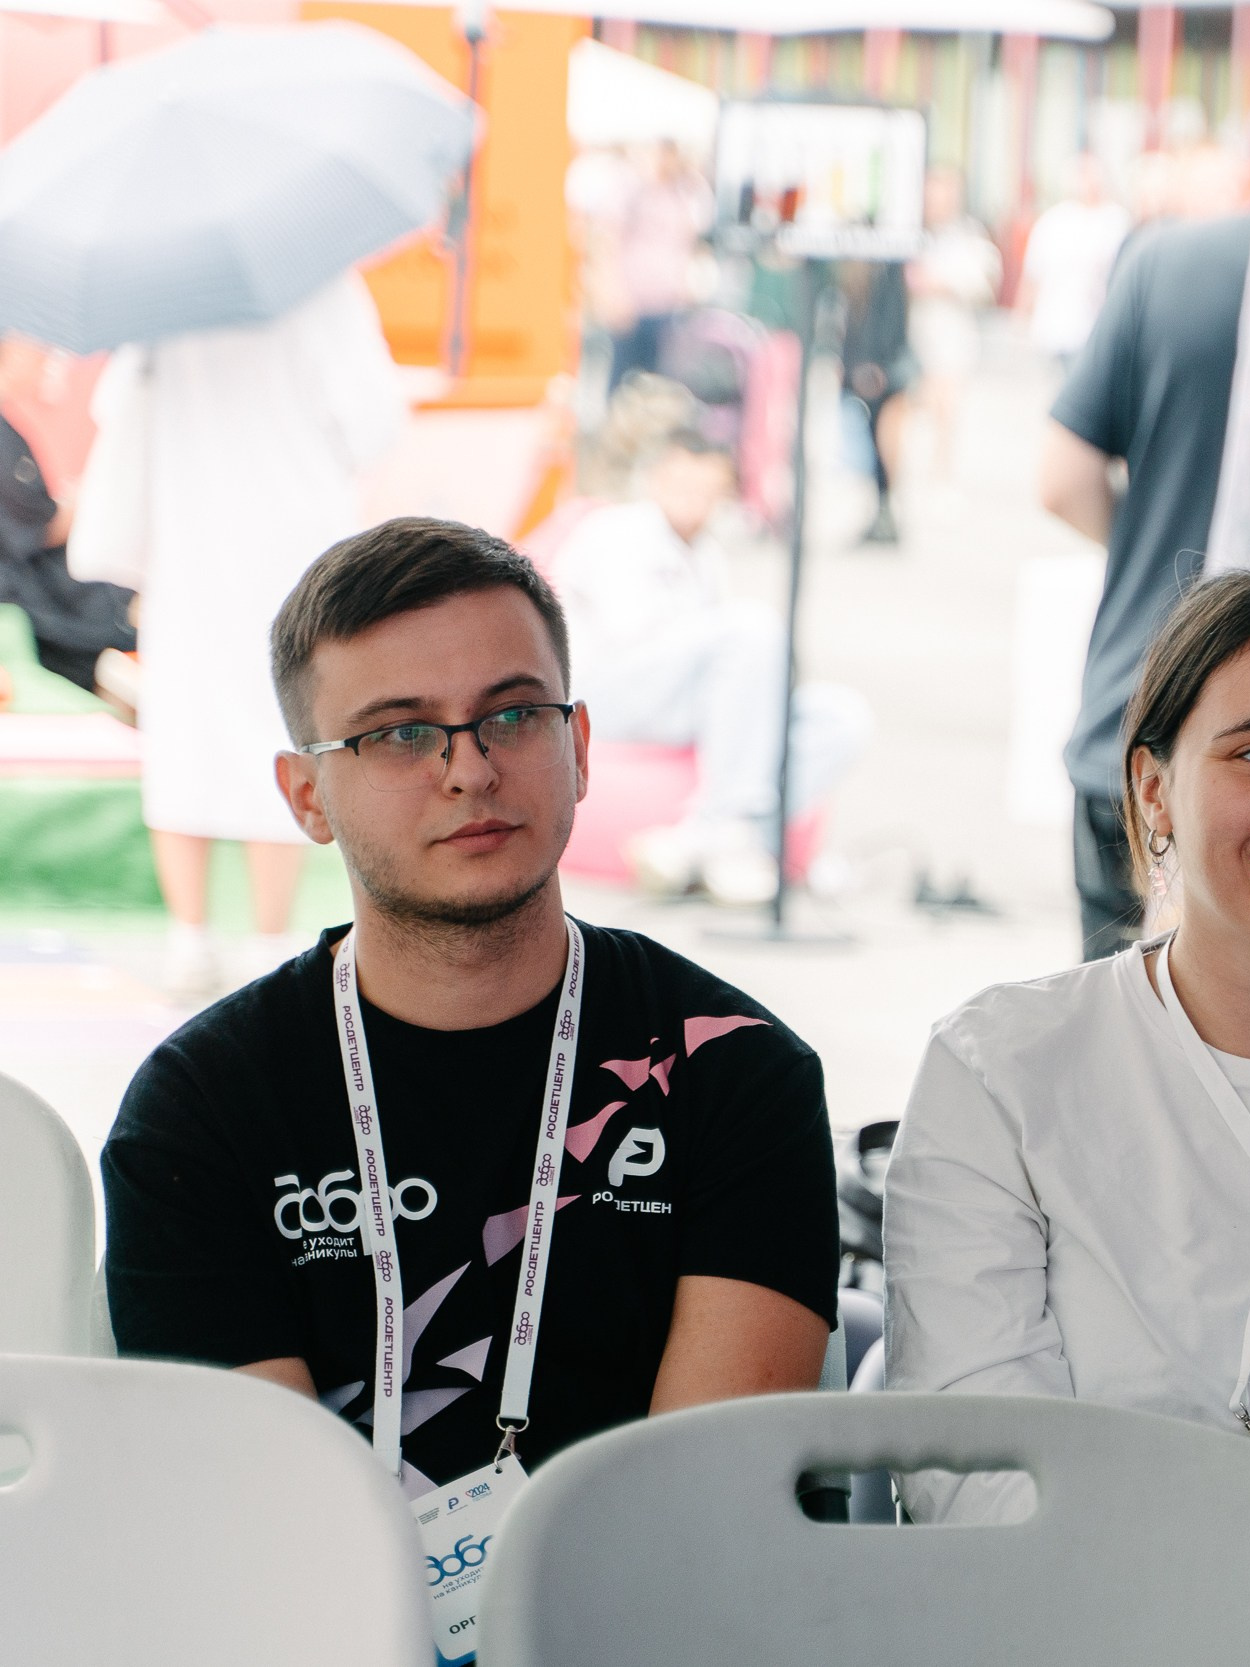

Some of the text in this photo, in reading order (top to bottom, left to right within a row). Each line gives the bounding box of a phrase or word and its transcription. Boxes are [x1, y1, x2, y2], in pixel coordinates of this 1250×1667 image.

[568, 923, 580, 998] РОСДЕТЦЕН
[343, 1005, 364, 1091] РОСДЕТЦЕНТР
[547, 1053, 565, 1139] РОСДЕТЦЕНТР
[365, 1148, 385, 1237] РОСДЕТЦЕНТР
[305, 1248, 358, 1263] никулы
[309, 1237, 354, 1250] уходит
[525, 1201, 545, 1296] РОСДЕТЦЕНТР
[383, 1297, 394, 1397] РОСДЕТЦЕНТР
[469, 1483, 491, 1498] 2024
[425, 1534, 493, 1586] доб
[456, 1567, 485, 1584] уходи
[433, 1575, 482, 1600] на канику
[449, 1615, 477, 1635] ОРГ
